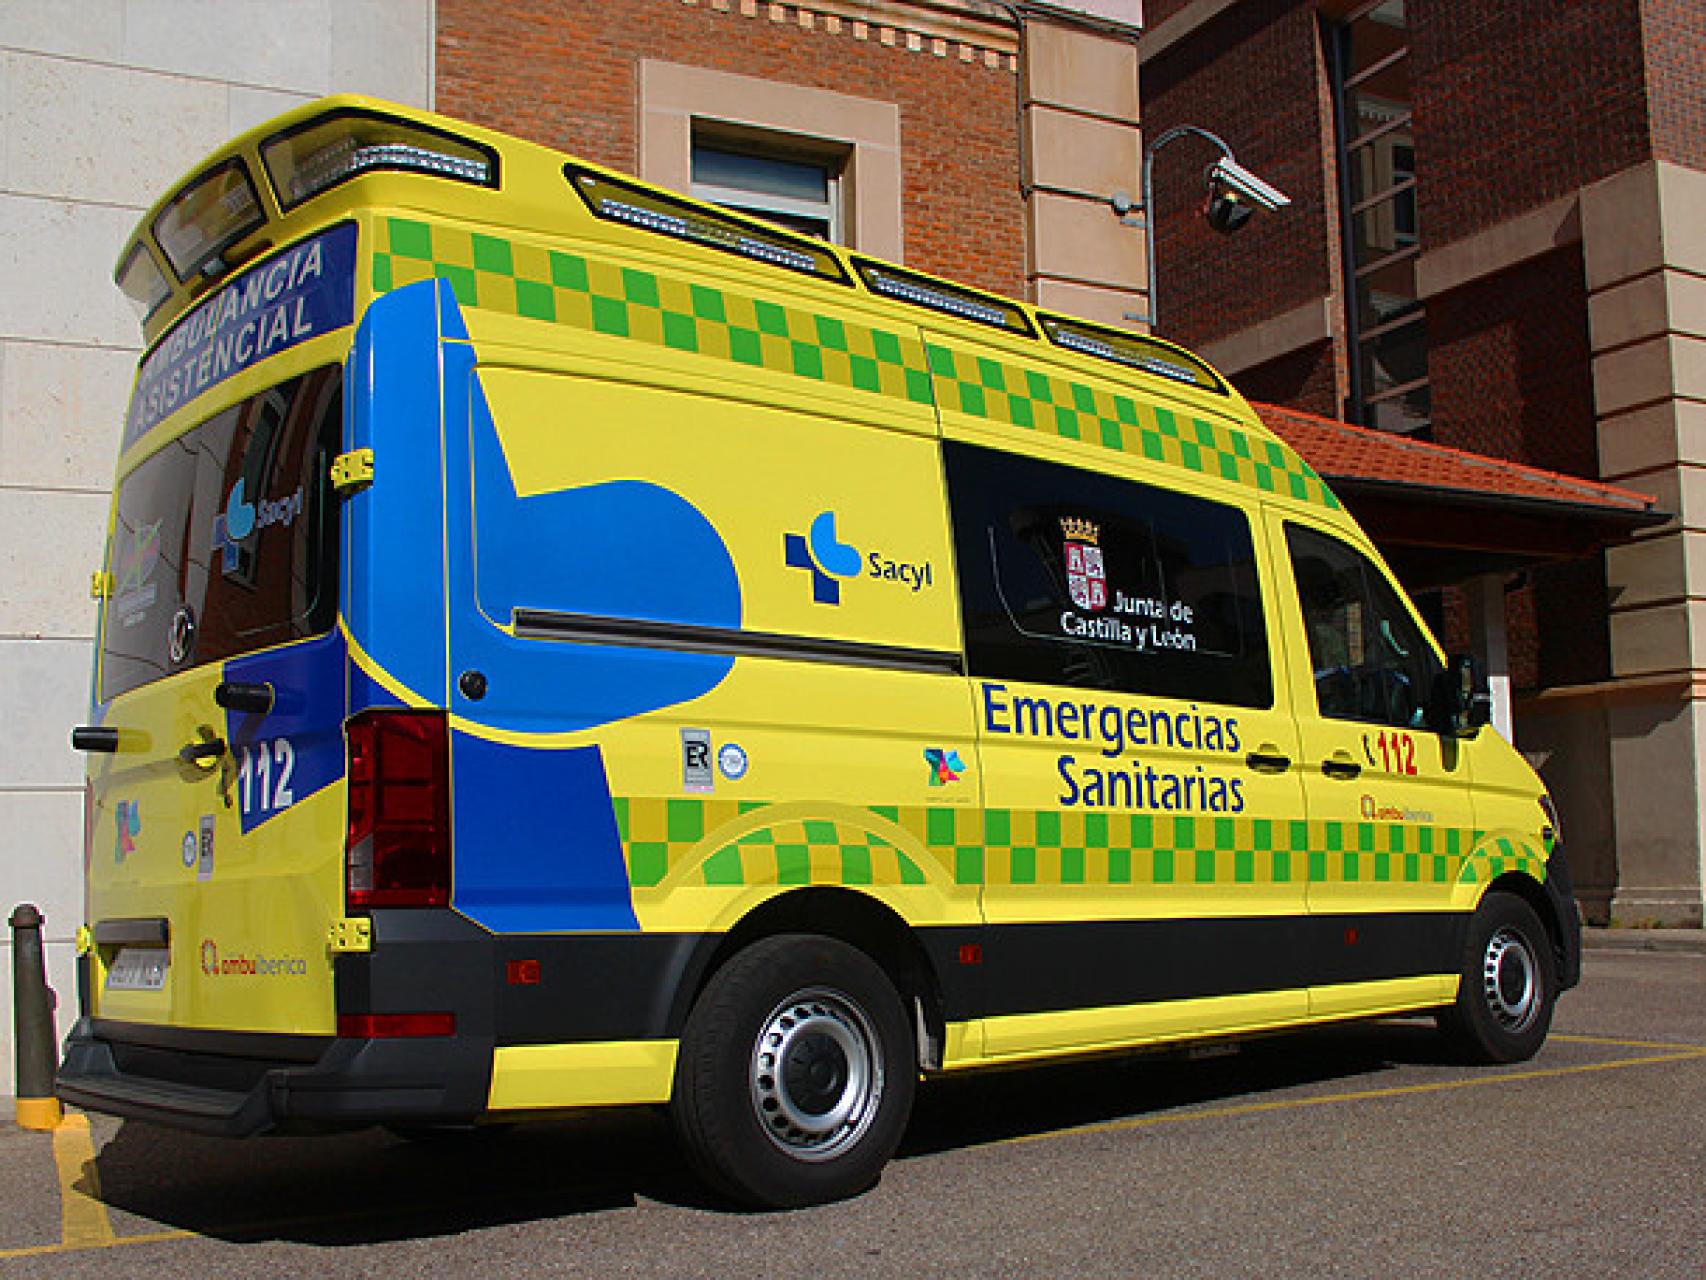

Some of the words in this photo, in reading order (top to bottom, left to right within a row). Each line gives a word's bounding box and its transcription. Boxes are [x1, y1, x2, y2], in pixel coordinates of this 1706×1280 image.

[136, 296, 312, 427] ASISTENCIAL
[257, 484, 303, 528] Sacyl
[868, 552, 933, 592] Sacyl
[1113, 589, 1164, 617] Junta
[1169, 600, 1194, 623] de
[1060, 611, 1132, 641] Castilla
[1135, 627, 1147, 650] y
[1152, 625, 1196, 651] León
[981, 682, 1241, 758] Emergencias
[239, 737, 294, 814] 112
[1377, 729, 1417, 776] 112
[1057, 755, 1245, 812] Sanitarias
